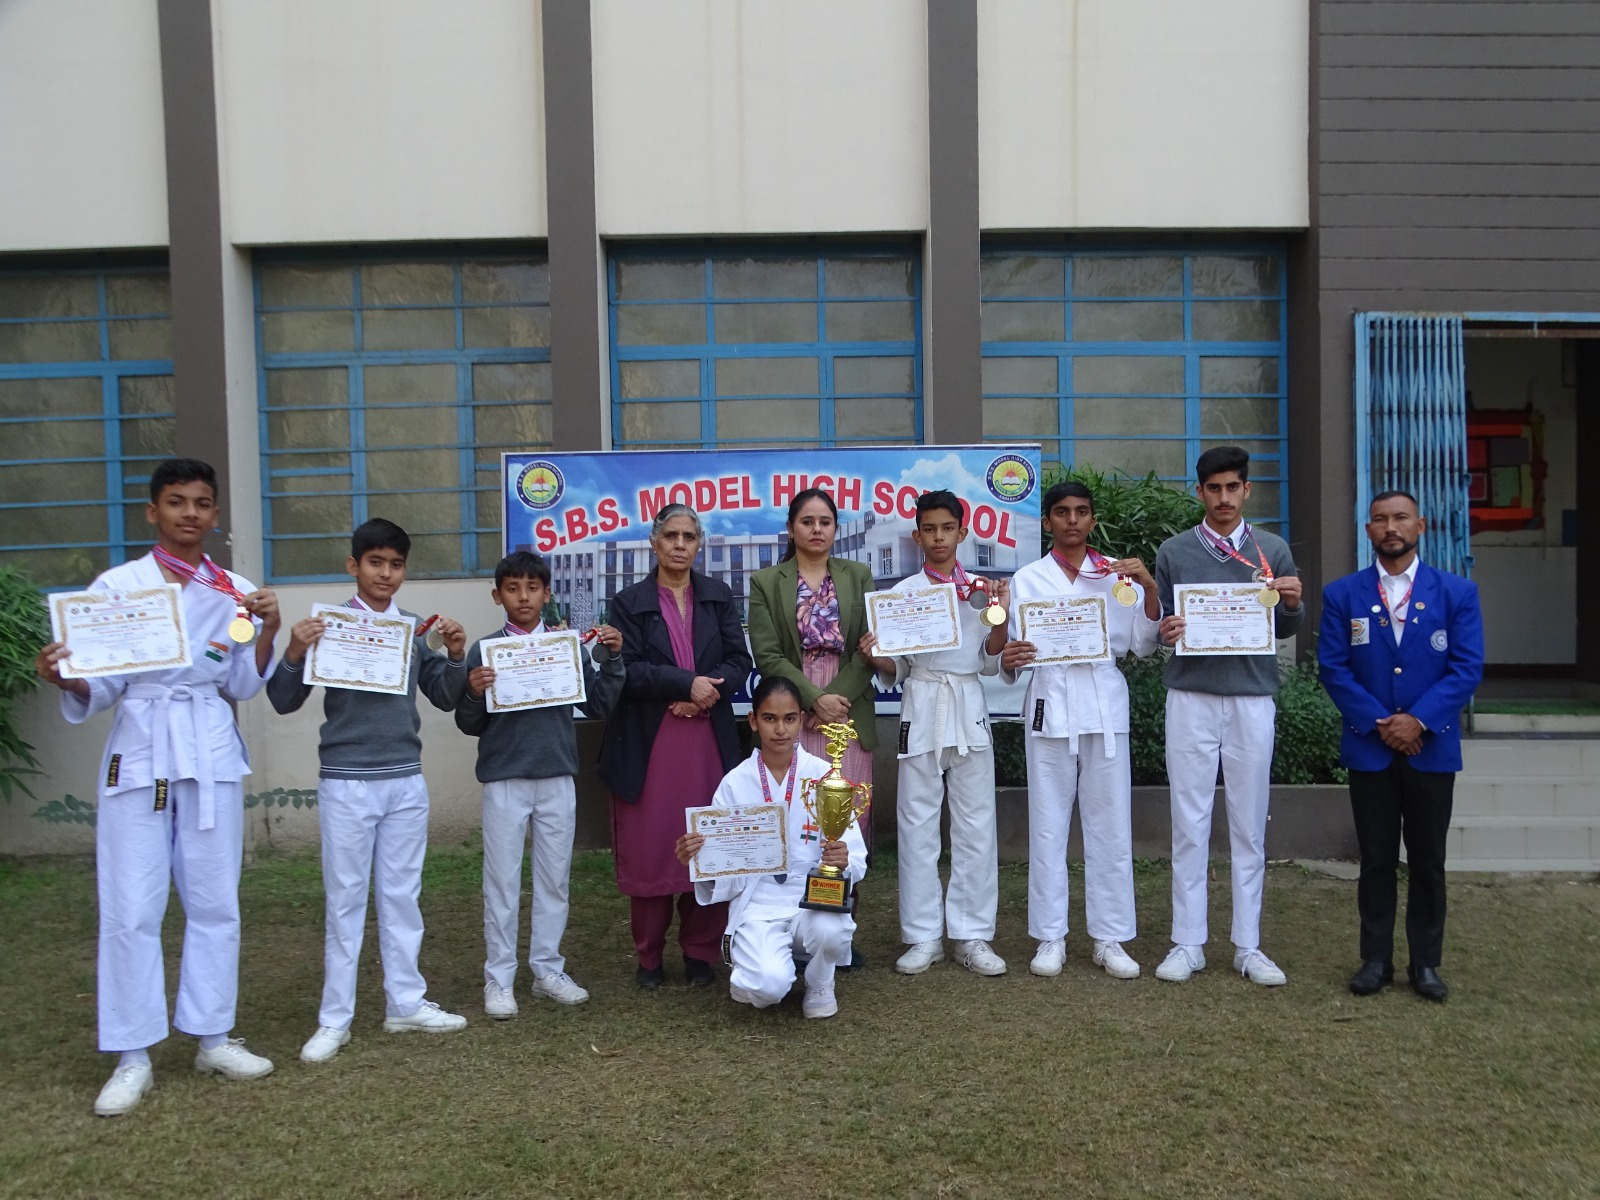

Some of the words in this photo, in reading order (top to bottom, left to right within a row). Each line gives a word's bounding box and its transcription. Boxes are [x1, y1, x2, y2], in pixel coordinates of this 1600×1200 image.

[535, 498, 629, 553] S.B.S.
[639, 476, 761, 522] MODEL
[872, 481, 1017, 549] SCOL
